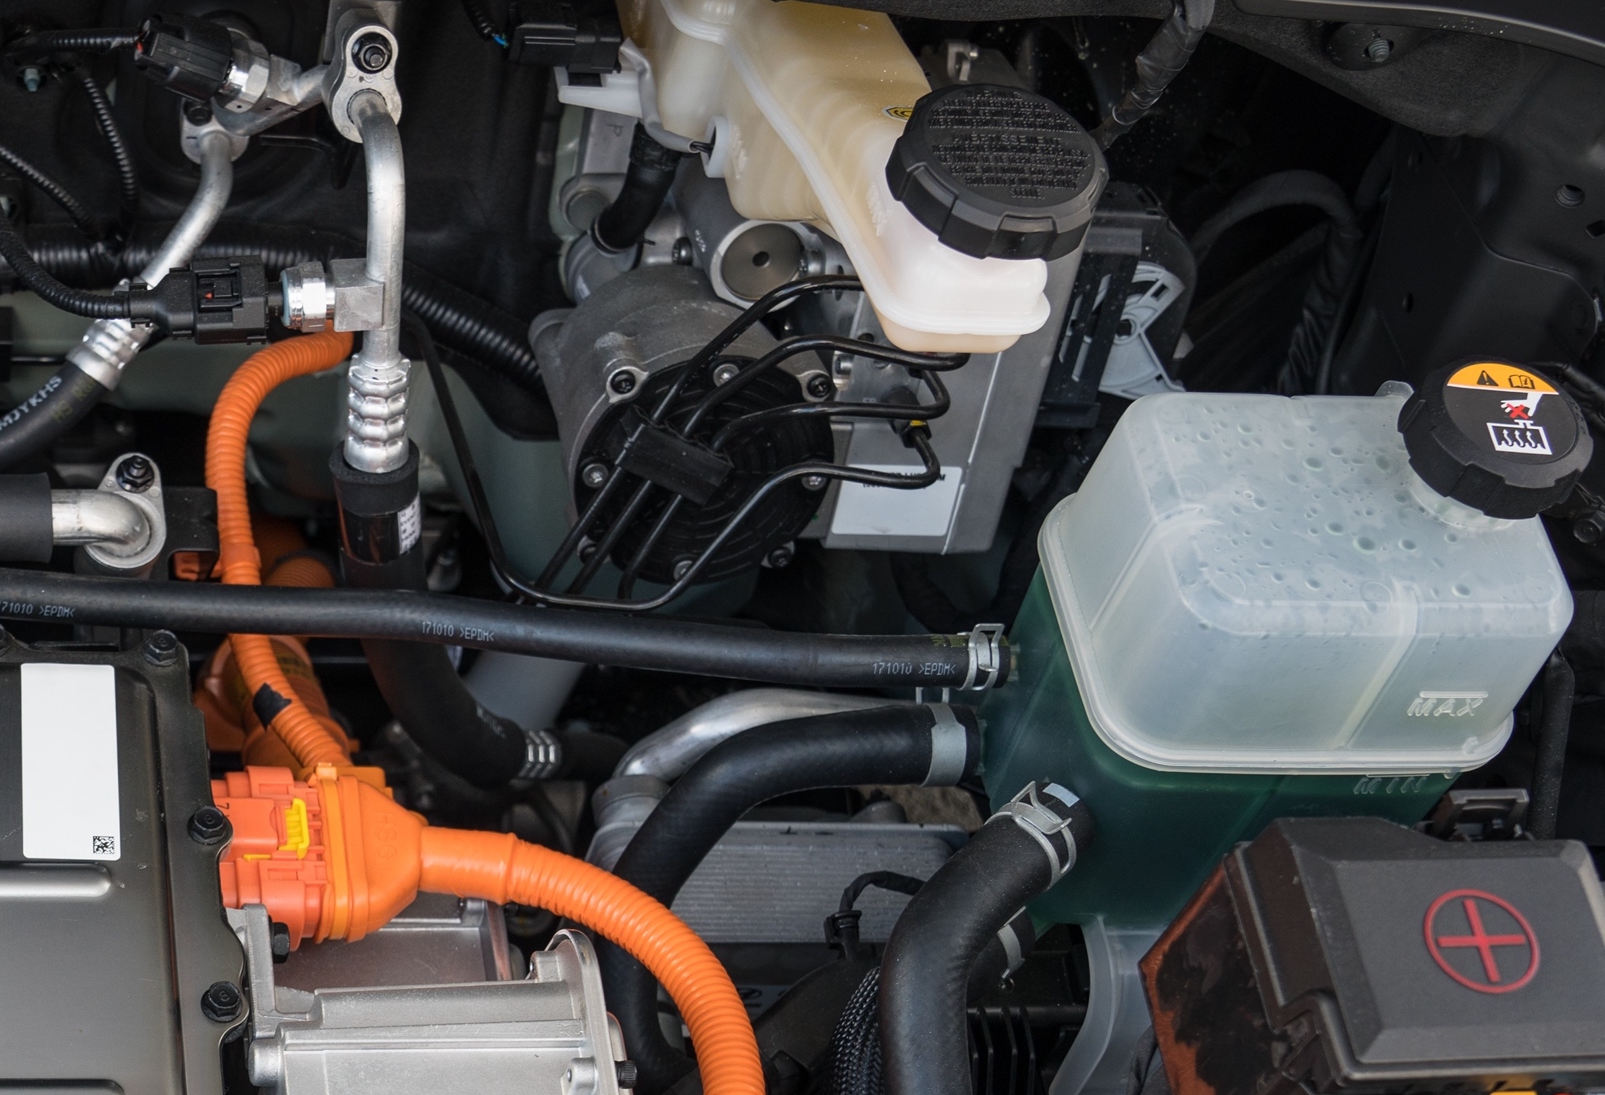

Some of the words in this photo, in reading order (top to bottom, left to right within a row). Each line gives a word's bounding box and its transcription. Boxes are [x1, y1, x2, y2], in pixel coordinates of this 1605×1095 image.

[421, 620, 455, 638] 171010
[459, 624, 495, 642] >EPDM<
[918, 662, 957, 676] >EPDM<
[1406, 697, 1484, 718] MAX
[1353, 776, 1429, 796] MIN
